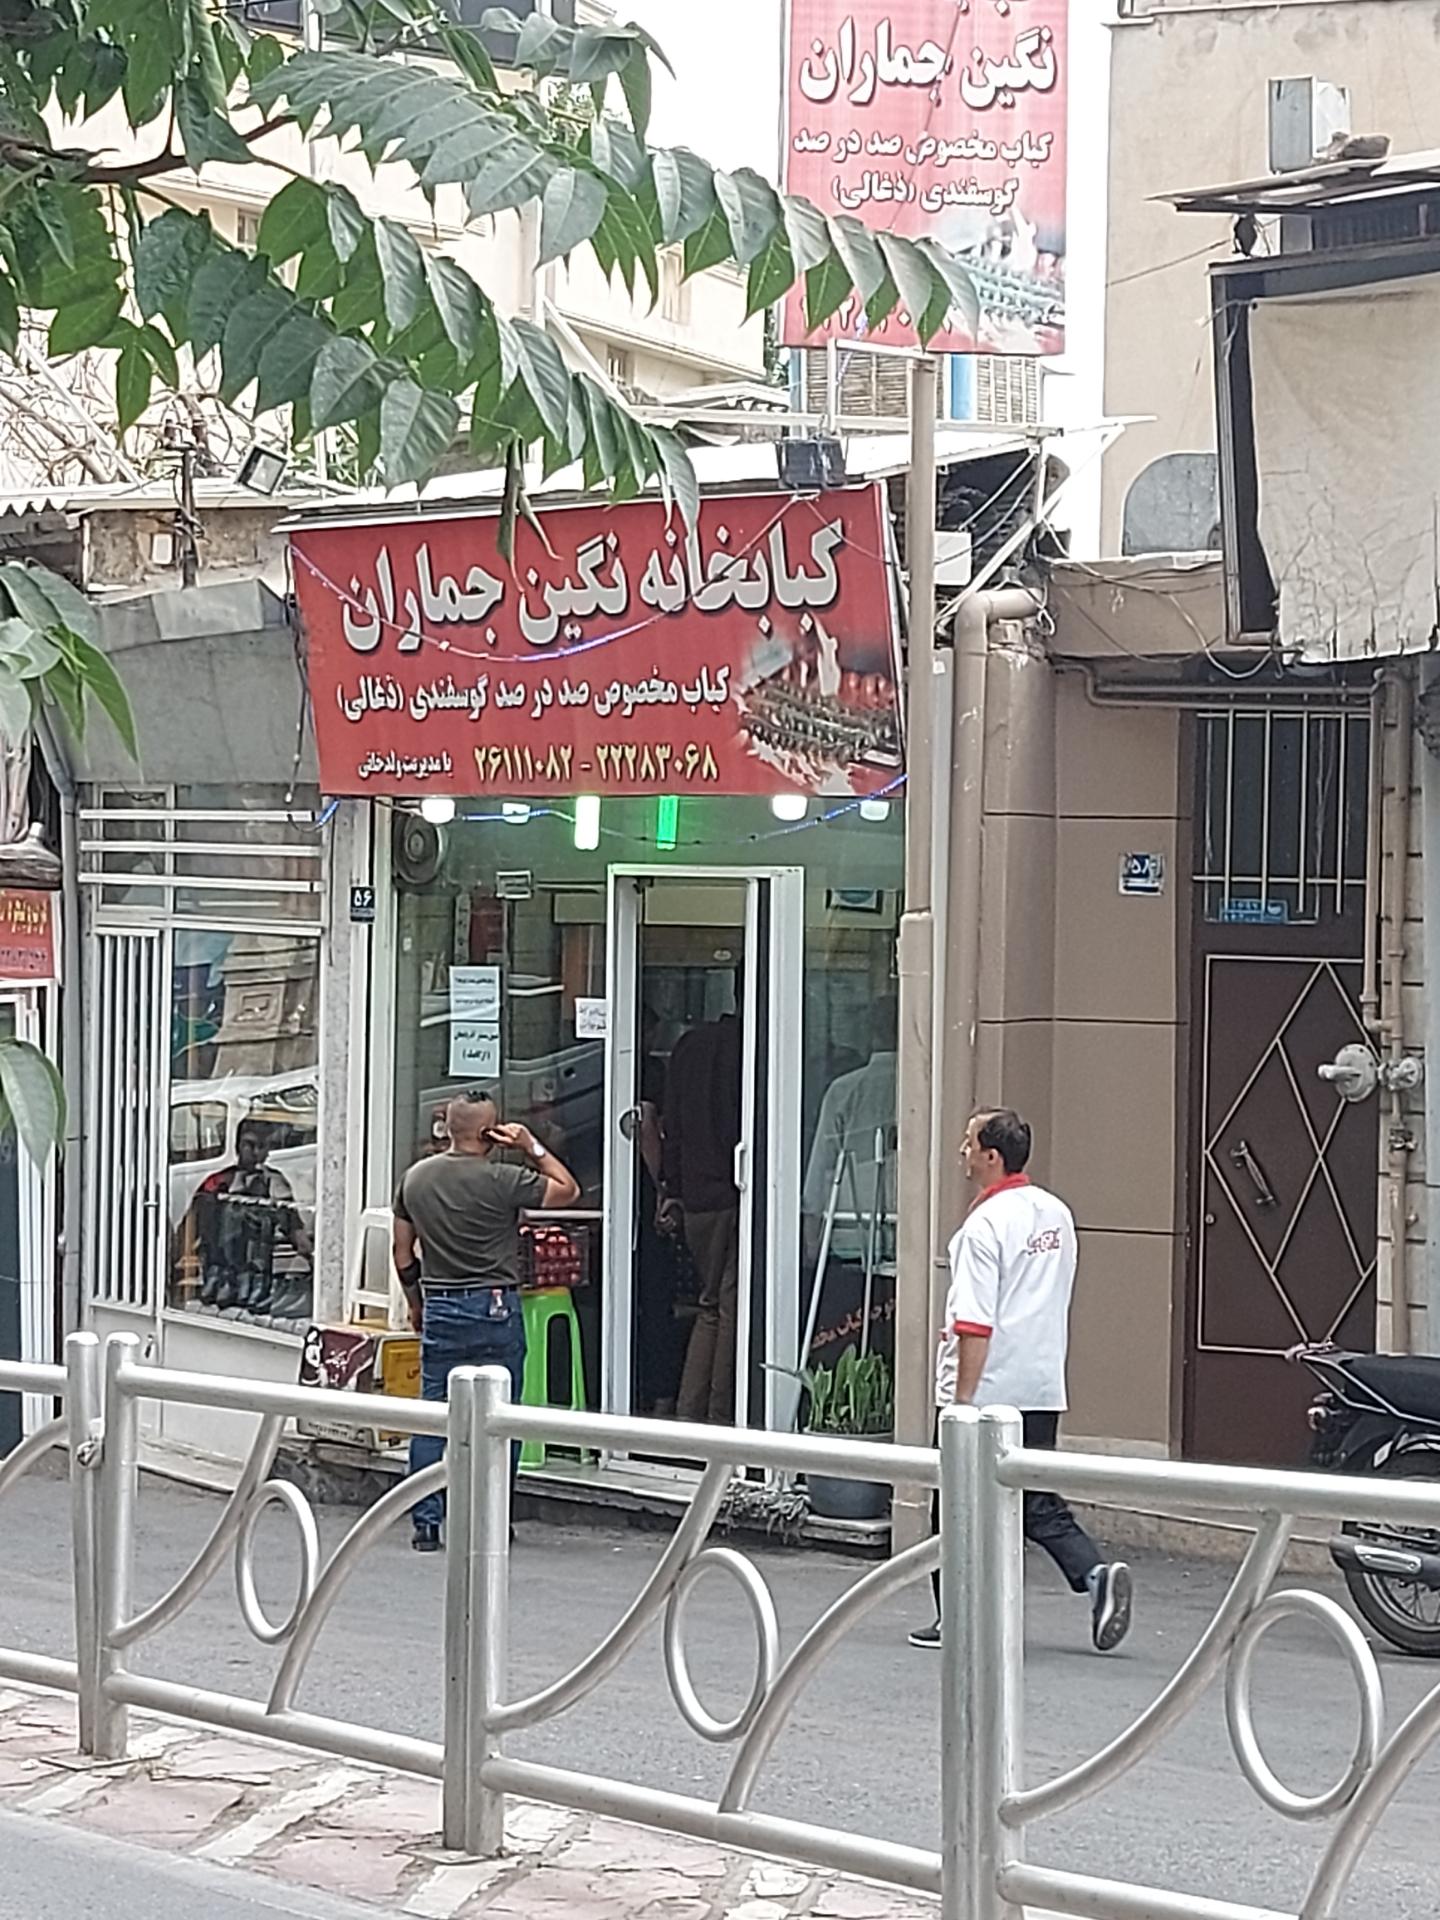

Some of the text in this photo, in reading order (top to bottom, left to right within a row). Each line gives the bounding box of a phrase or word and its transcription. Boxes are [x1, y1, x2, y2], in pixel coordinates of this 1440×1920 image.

[799, 16, 1058, 110] نگین جماران
[793, 128, 1055, 168] کباب مخصوص صد در صد
[918, 175, 1020, 214] گوسفندی
[341, 519, 844, 653] کبابخانه نگین جماران
[409, 672, 489, 721] گوسفندی
[494, 678, 525, 708] صد
[530, 677, 553, 718] در
[557, 678, 589, 707] صد
[593, 665, 679, 717] مخصوص
[681, 665, 731, 713] کباب
[354, 889, 373, 907] ۵۶
